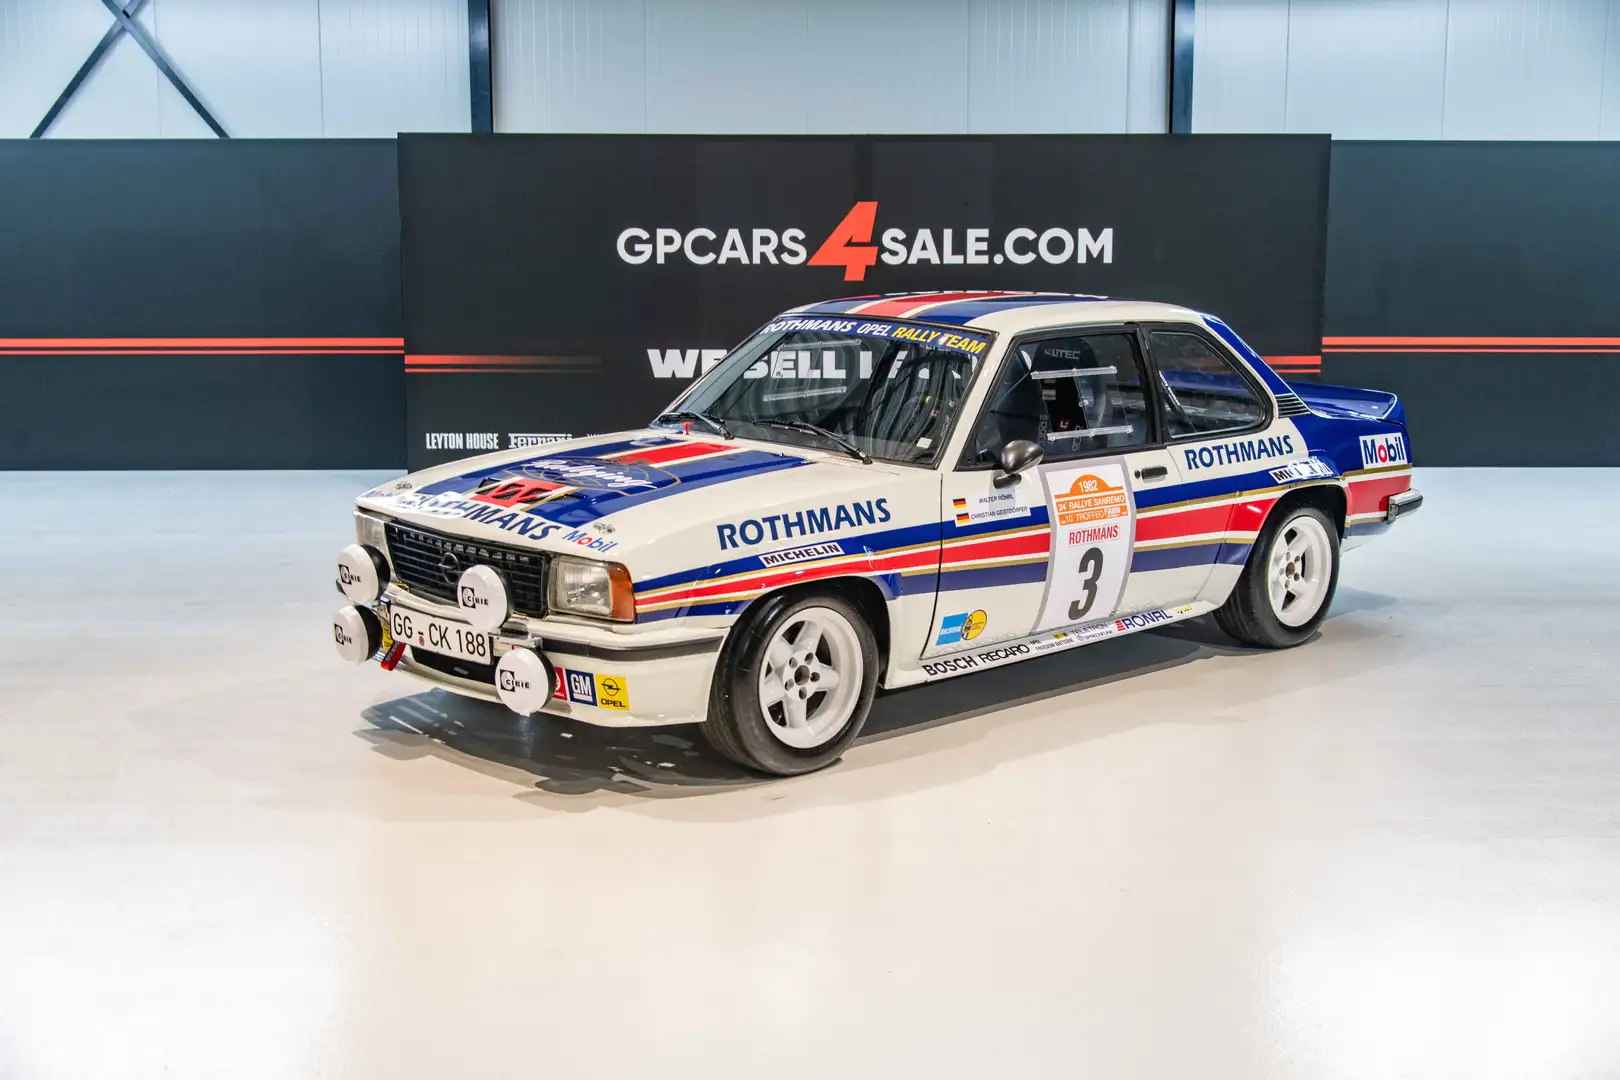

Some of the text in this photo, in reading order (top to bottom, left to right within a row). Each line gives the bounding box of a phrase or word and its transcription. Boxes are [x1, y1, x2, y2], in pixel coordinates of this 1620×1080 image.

[763, 319, 987, 354] ROTHMANS OPEL RALLY TEAM
[647, 349, 727, 379] WE
[743, 350, 846, 379] SELL
[426, 433, 499, 450] LEYTON HOUSE
[1184, 434, 1294, 471] ROTHMANS
[1363, 435, 1405, 465] Mobil
[1078, 480, 1098, 492] 1982
[1069, 499, 1092, 509] RALLYE
[1093, 495, 1124, 506] SANREMO
[716, 498, 891, 550] ROTHMANS
[971, 510, 995, 520] CHRISTIAN
[563, 529, 616, 553] Mobil
[1069, 525, 1119, 545] ROTHMANS
[763, 544, 840, 565] MICHELIN
[1068, 547, 1104, 620] 3
[1071, 622, 1108, 635] TELETRON
[1121, 609, 1173, 630] RONAL
[394, 612, 413, 639] GG
[428, 625, 452, 650] CK
[455, 629, 486, 657] 188
[1035, 643, 1055, 652] FREEDOM
[921, 644, 1030, 676] BOSCH RECARO
[571, 673, 592, 697] GM
[600, 698, 626, 708] OPEL
